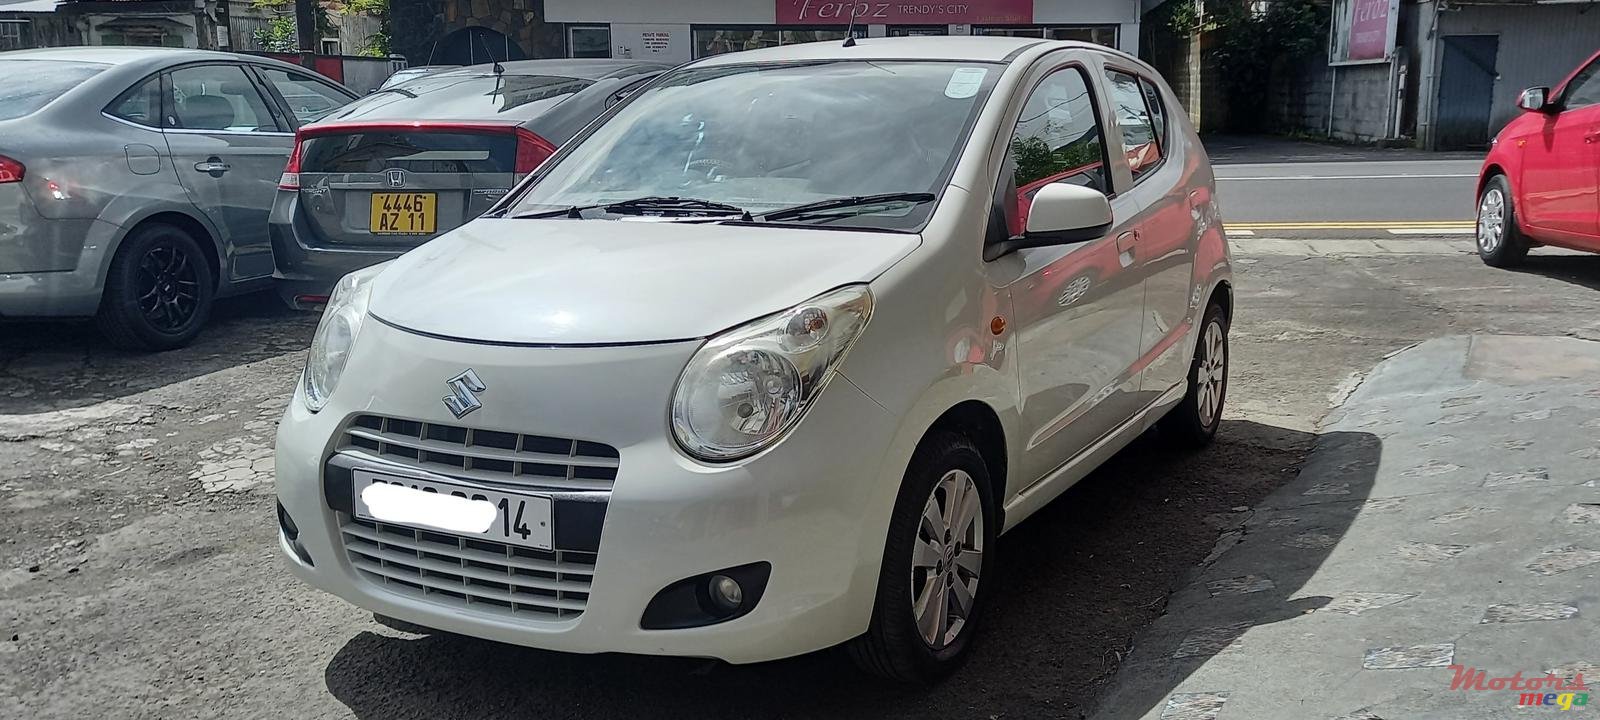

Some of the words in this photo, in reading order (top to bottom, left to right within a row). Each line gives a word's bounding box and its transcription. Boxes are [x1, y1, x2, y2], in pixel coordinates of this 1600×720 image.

[898, 5, 944, 14] TRENDY'S
[947, 5, 969, 14] CITY
[383, 194, 423, 212] 4446
[379, 212, 399, 231] AZ
[408, 212, 425, 230] 11
[497, 498, 531, 540] 14
